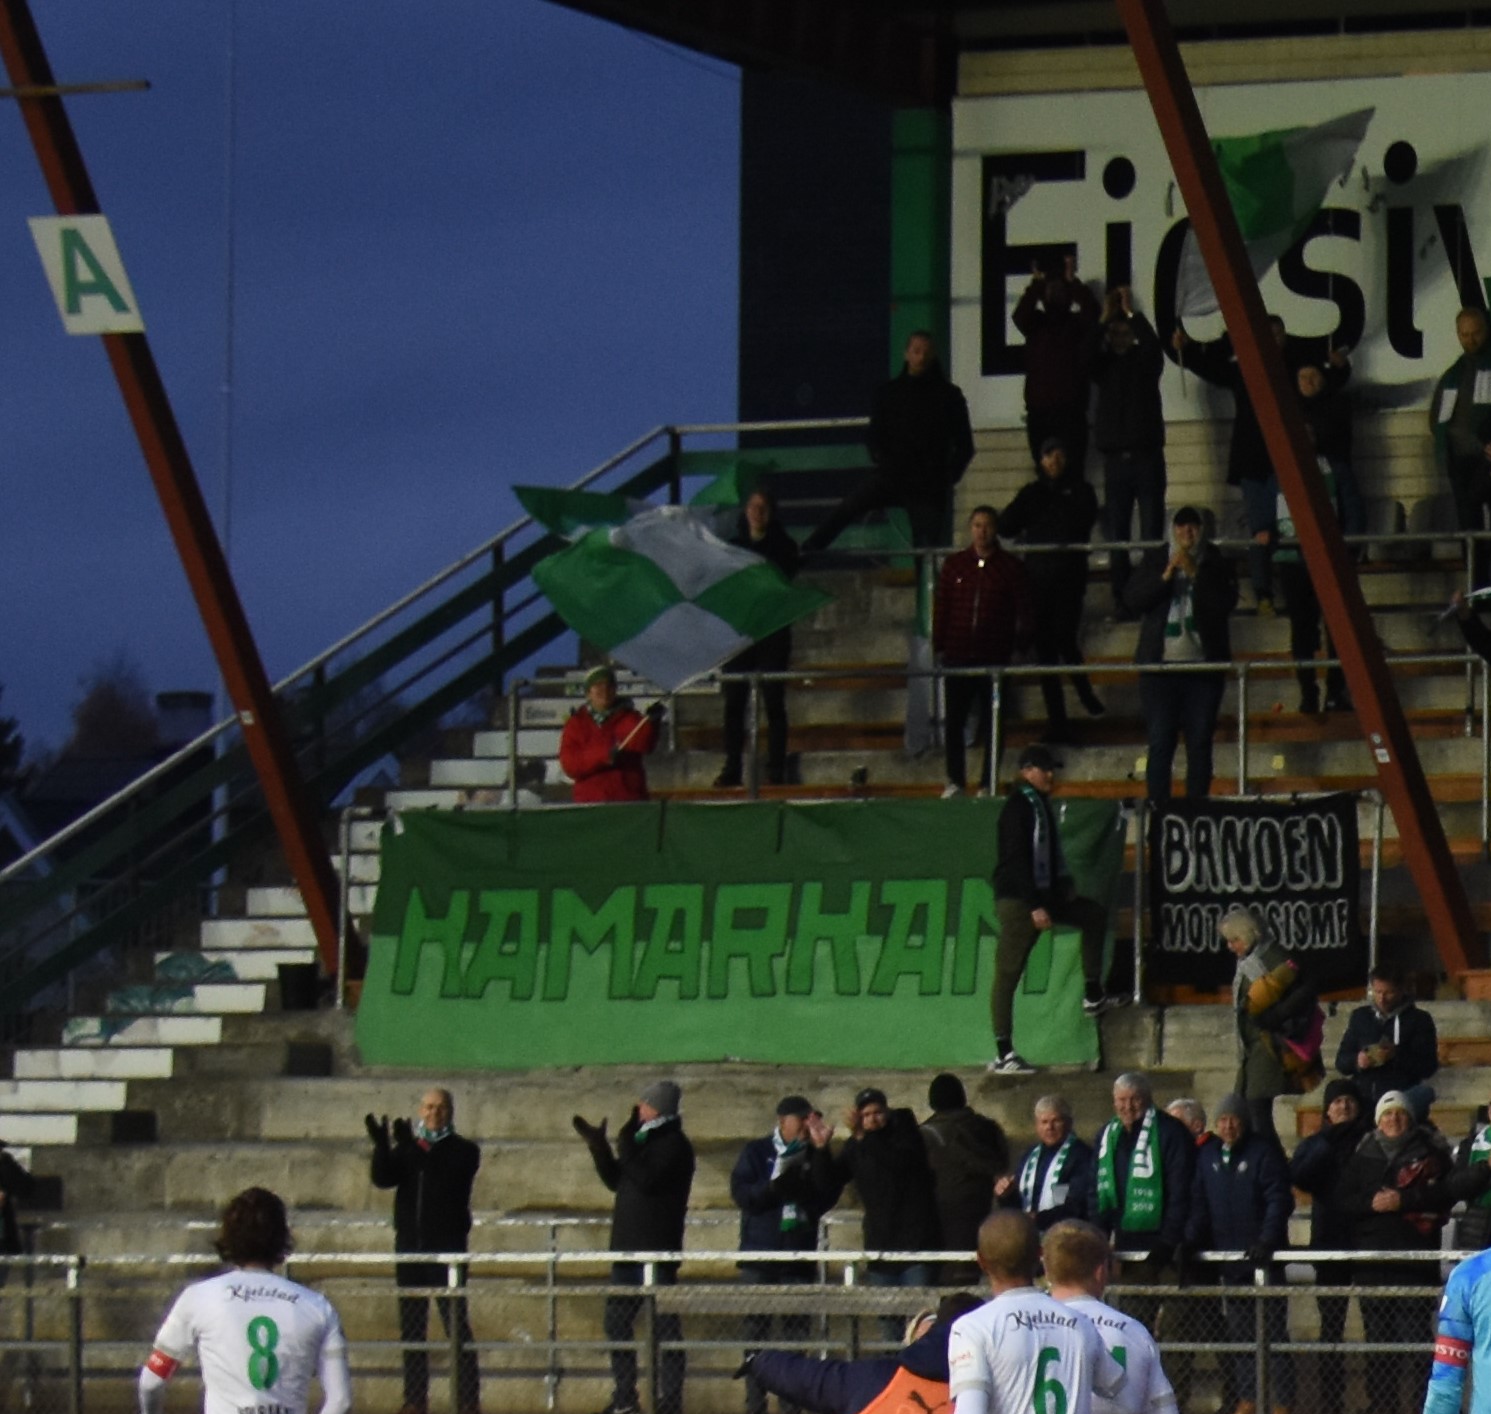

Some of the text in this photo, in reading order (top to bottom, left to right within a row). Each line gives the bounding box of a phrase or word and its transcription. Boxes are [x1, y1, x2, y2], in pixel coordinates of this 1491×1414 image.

[60, 227, 131, 315] A
[1225, 898, 1350, 951] SISME
[1006, 1310, 1079, 1331] Kjelstad
[247, 1316, 279, 1391] 8
